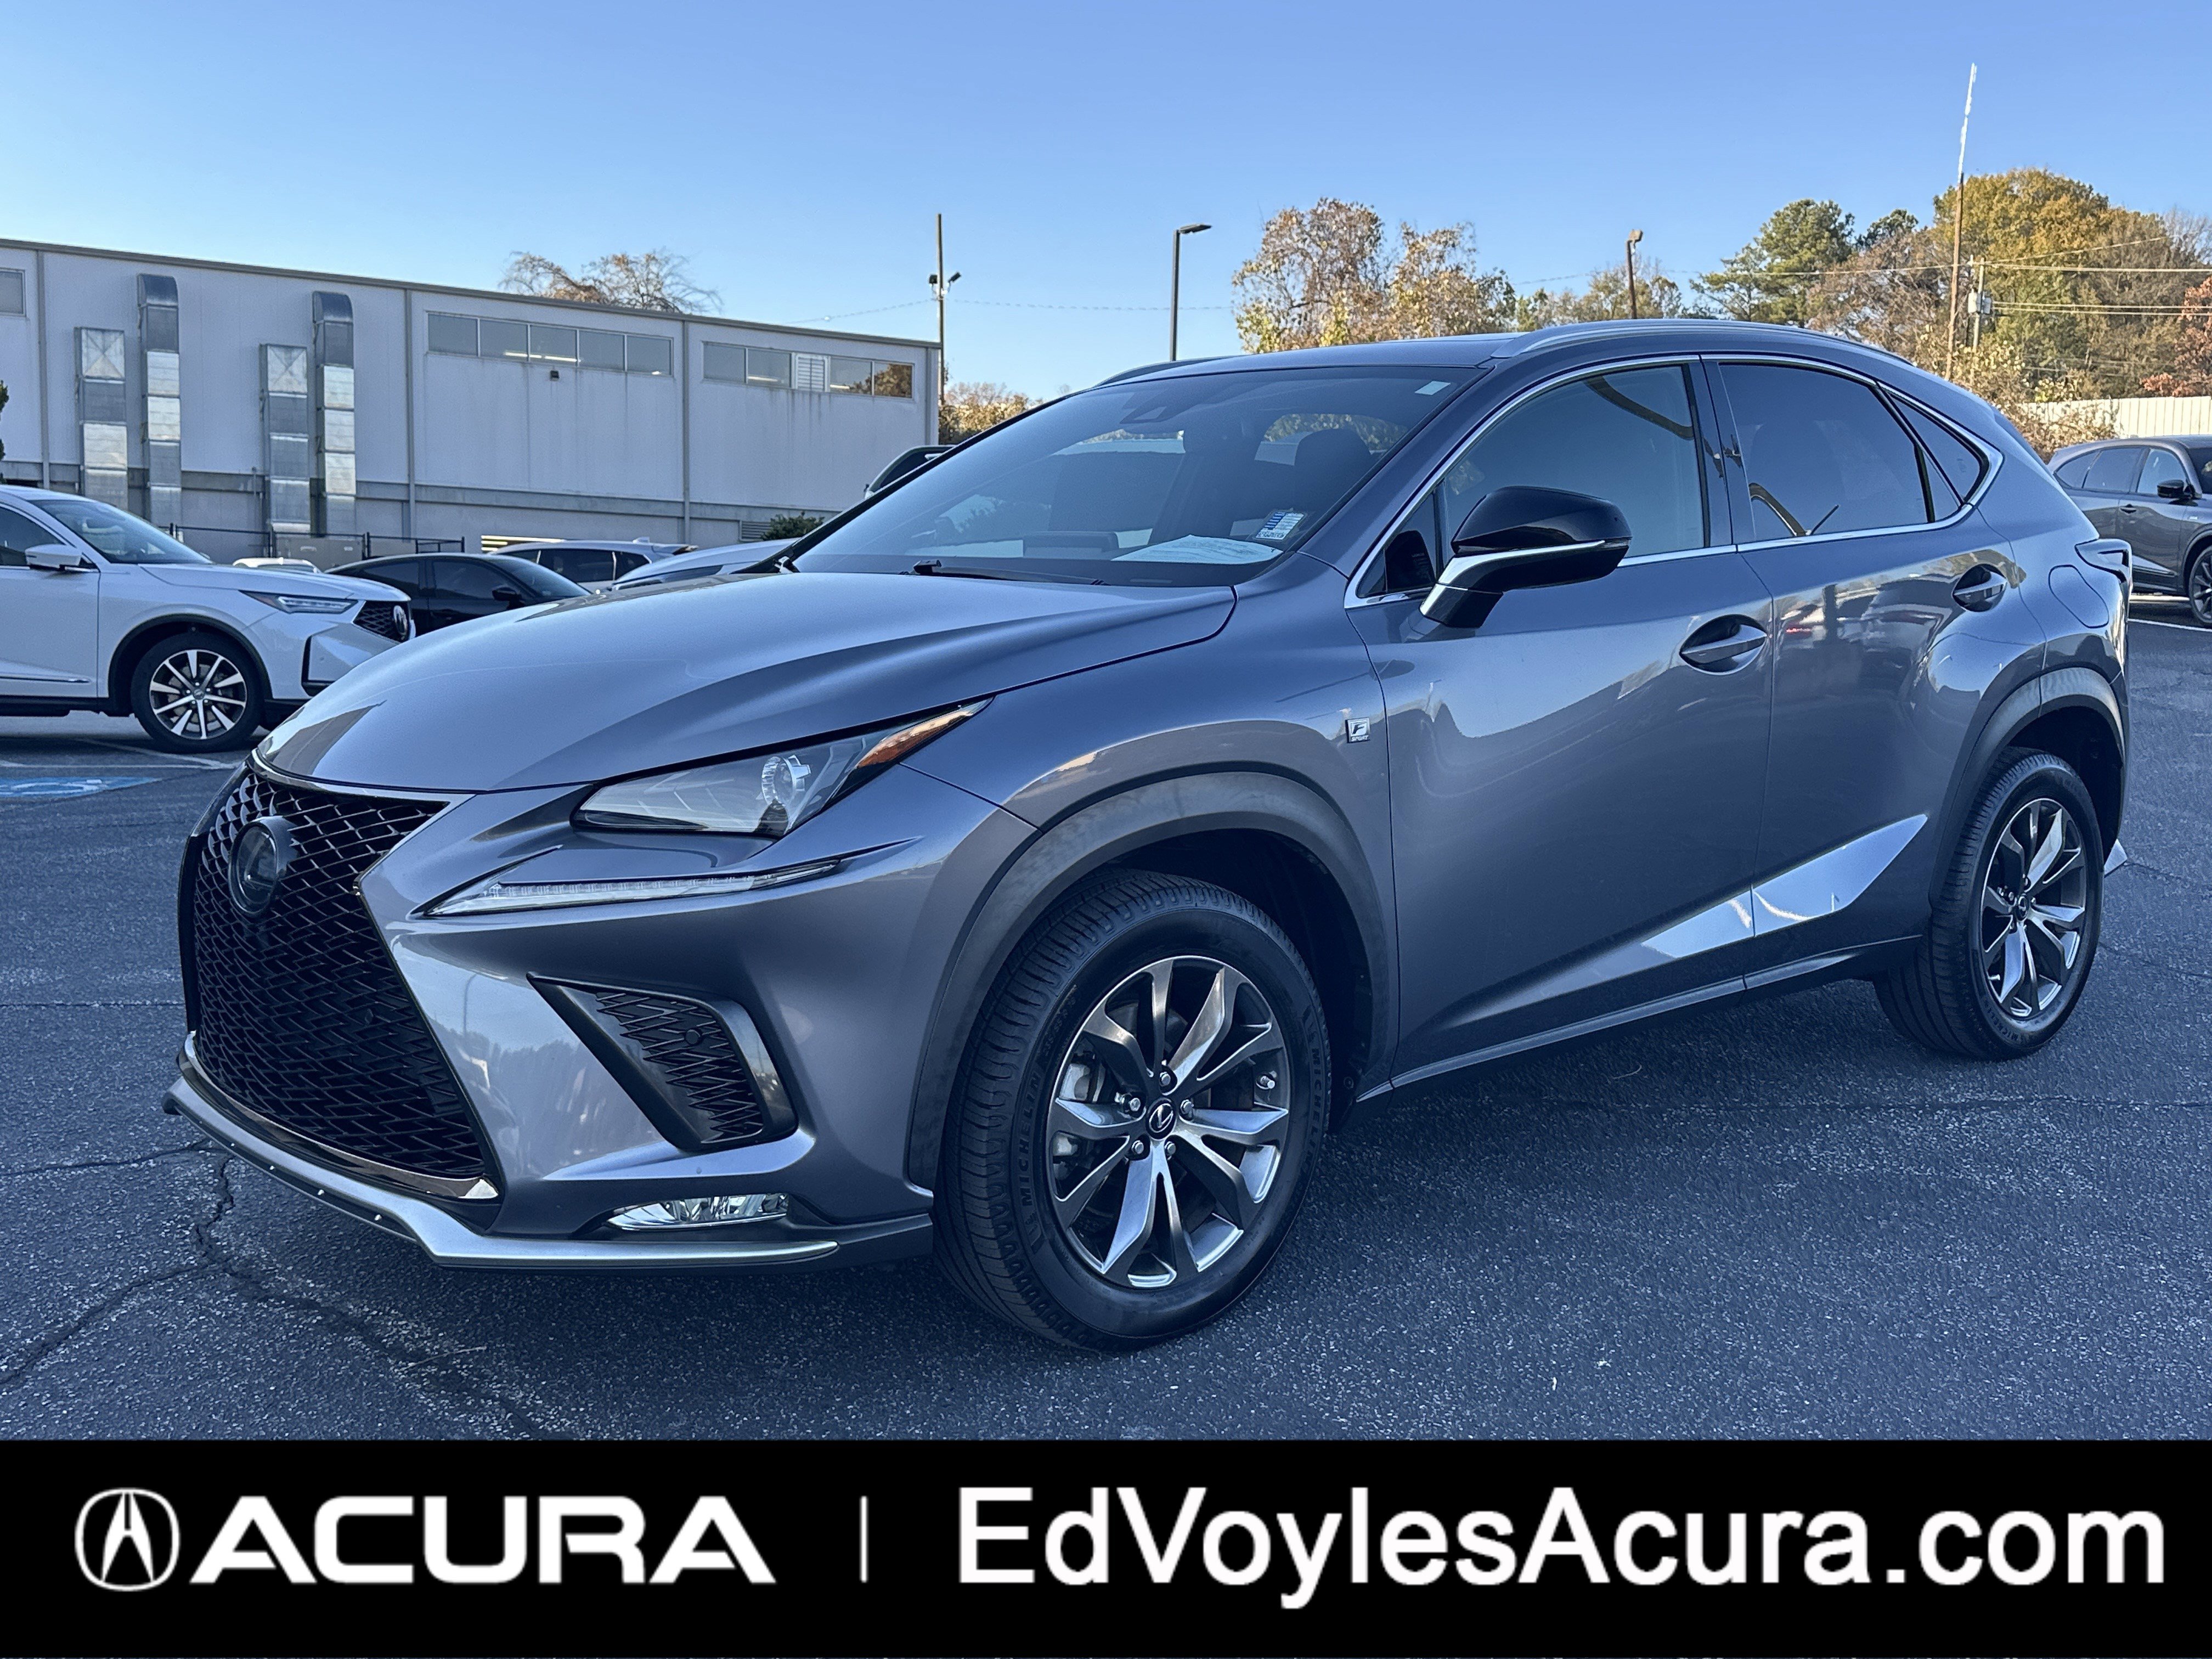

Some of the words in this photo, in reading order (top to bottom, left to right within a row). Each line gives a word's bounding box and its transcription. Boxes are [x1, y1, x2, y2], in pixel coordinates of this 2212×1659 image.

[1352, 723, 1366, 735] F
[1018, 1072, 1041, 1206] MICHELIN
[1306, 1048, 1322, 1167] MICHELIN
